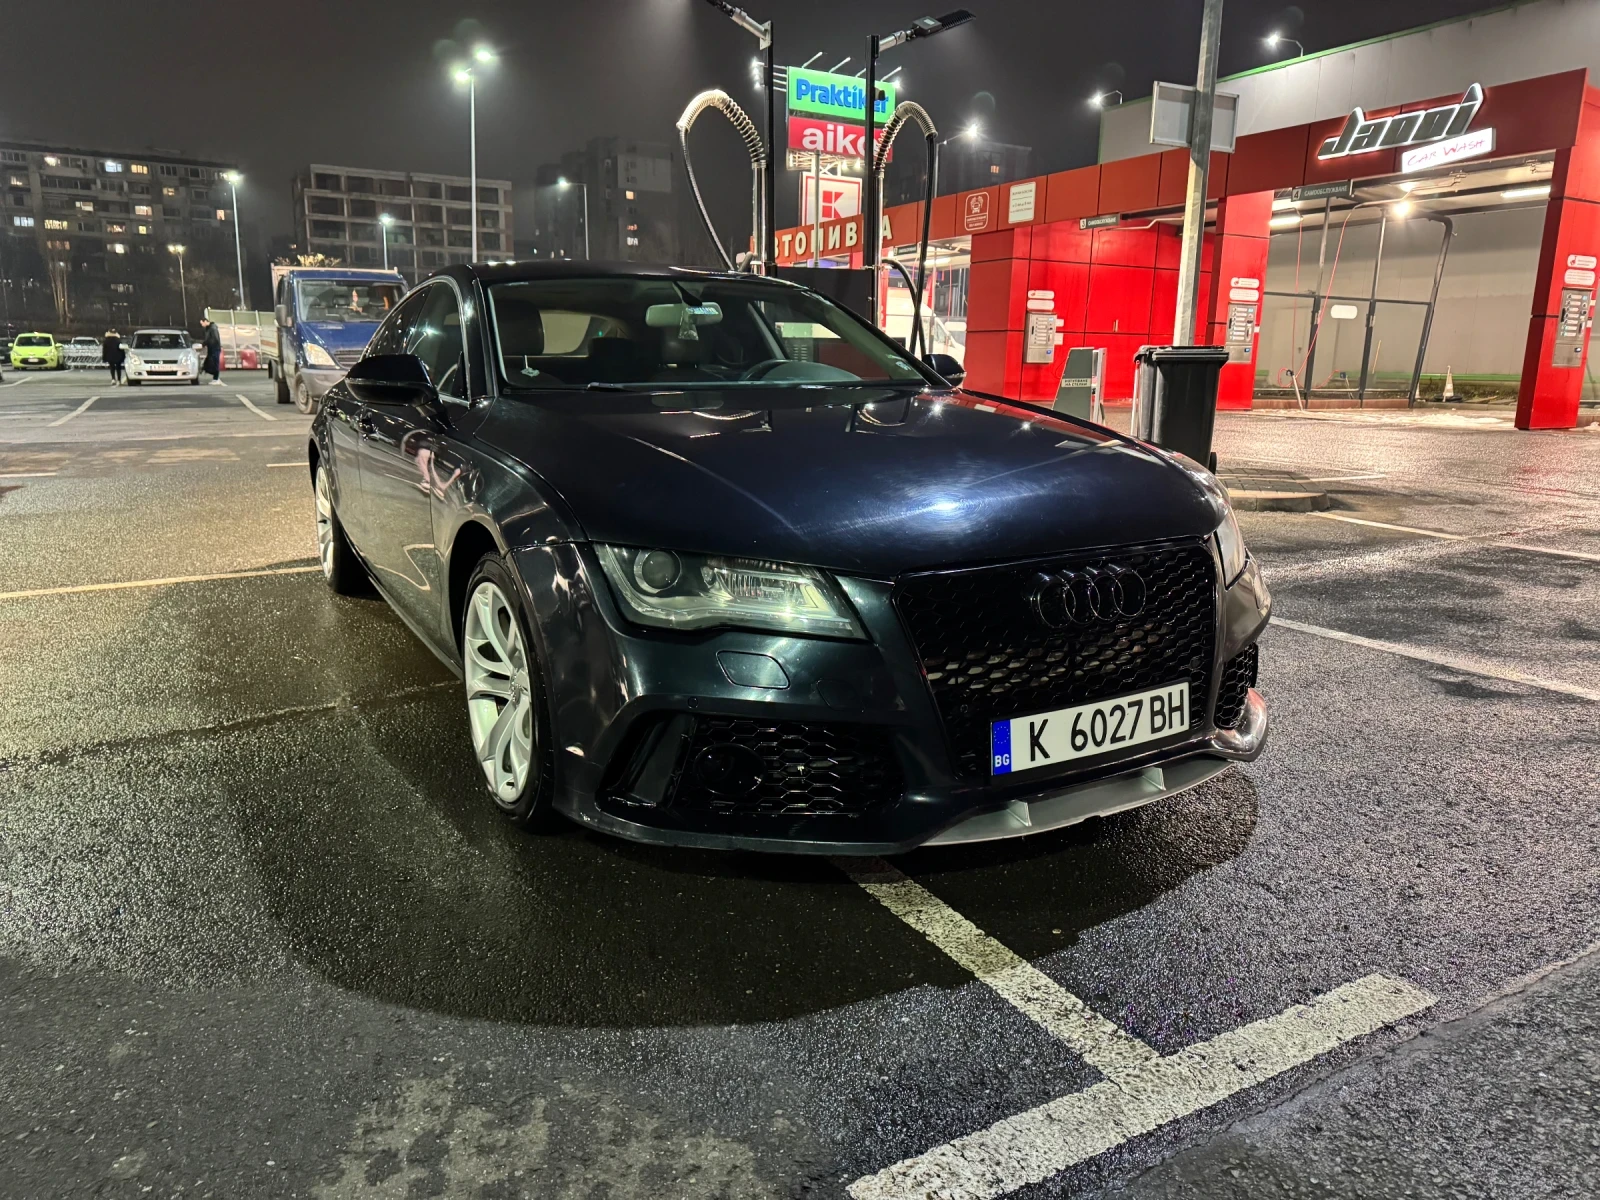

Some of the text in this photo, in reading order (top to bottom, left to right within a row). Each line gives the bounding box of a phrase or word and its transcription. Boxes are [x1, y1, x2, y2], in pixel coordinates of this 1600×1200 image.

[1408, 139, 1485, 166] CAR WASH
[1293, 190, 1300, 199] 4
[1029, 689, 1185, 762] K 6027 BH
[994, 753, 1010, 768] BG
